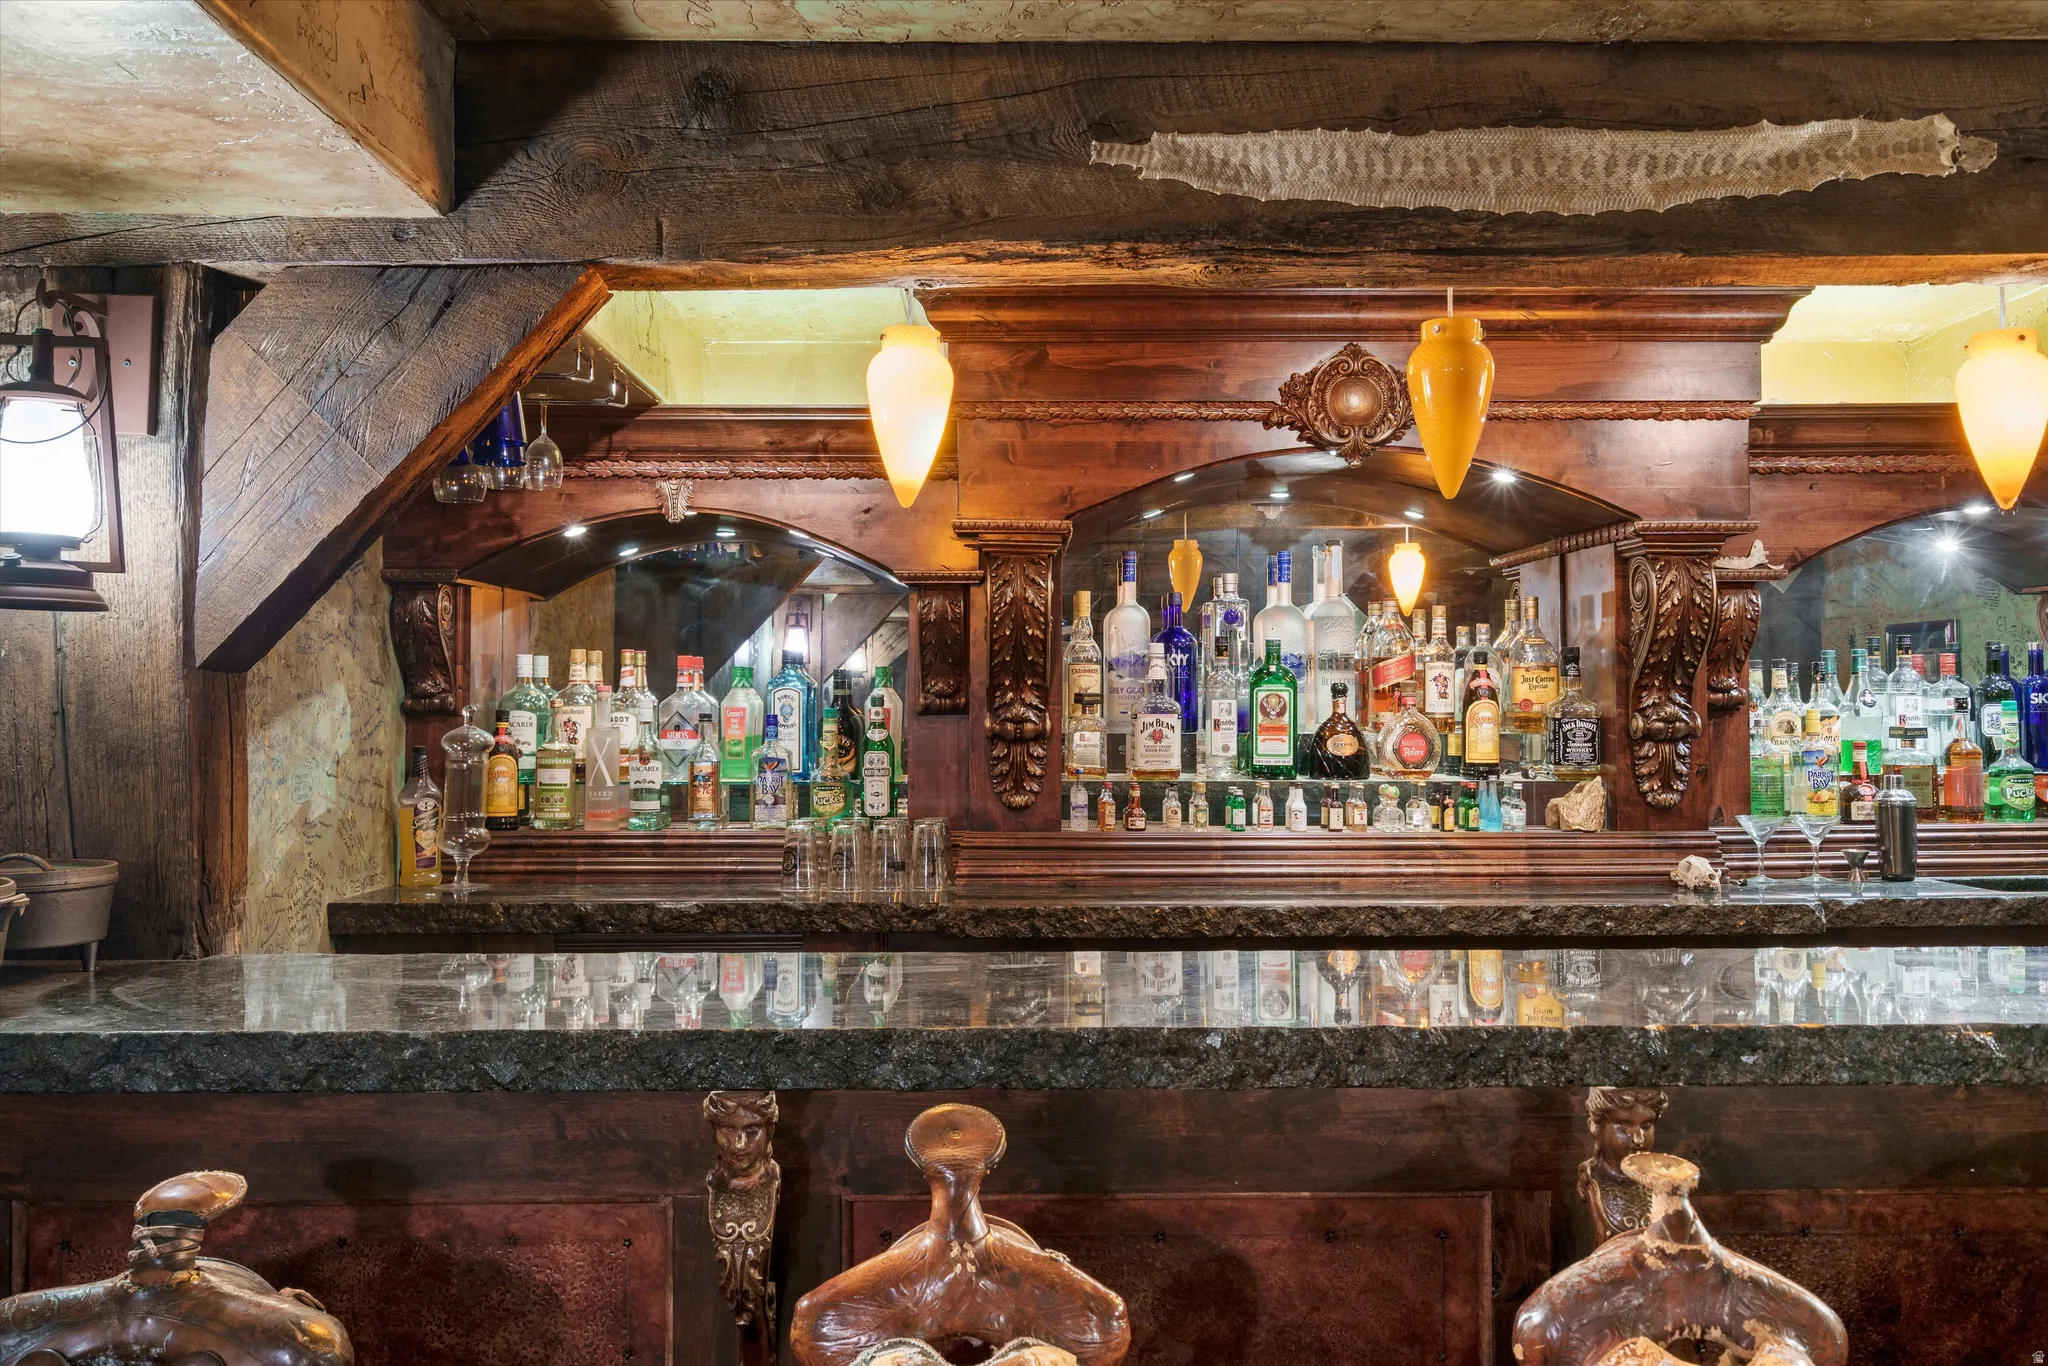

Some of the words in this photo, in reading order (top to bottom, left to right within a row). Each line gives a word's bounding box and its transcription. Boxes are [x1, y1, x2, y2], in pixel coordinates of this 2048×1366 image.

[1166, 653, 1190, 666] KYY
[1520, 675, 1535, 684] Jose
[1535, 675, 1555, 684] Cuervo
[1109, 687, 1124, 695] GREY
[1126, 687, 1144, 695] GOO
[2030, 692, 2048, 705] SK
[1140, 720, 1155, 734] JIM
[1155, 718, 1175, 734] BEAM
[1562, 721, 1576, 732] JACK
[1575, 719, 1598, 732] DANIEL'S
[666, 731, 689, 739] GILBEY'S
[587, 737, 615, 788] X
[757, 775, 784, 789] PARROT
[1807, 770, 1835, 783] PARROT
[761, 784, 780, 795] BAY
[1812, 779, 1831, 790] BAY
[813, 793, 845, 807] Pucker
